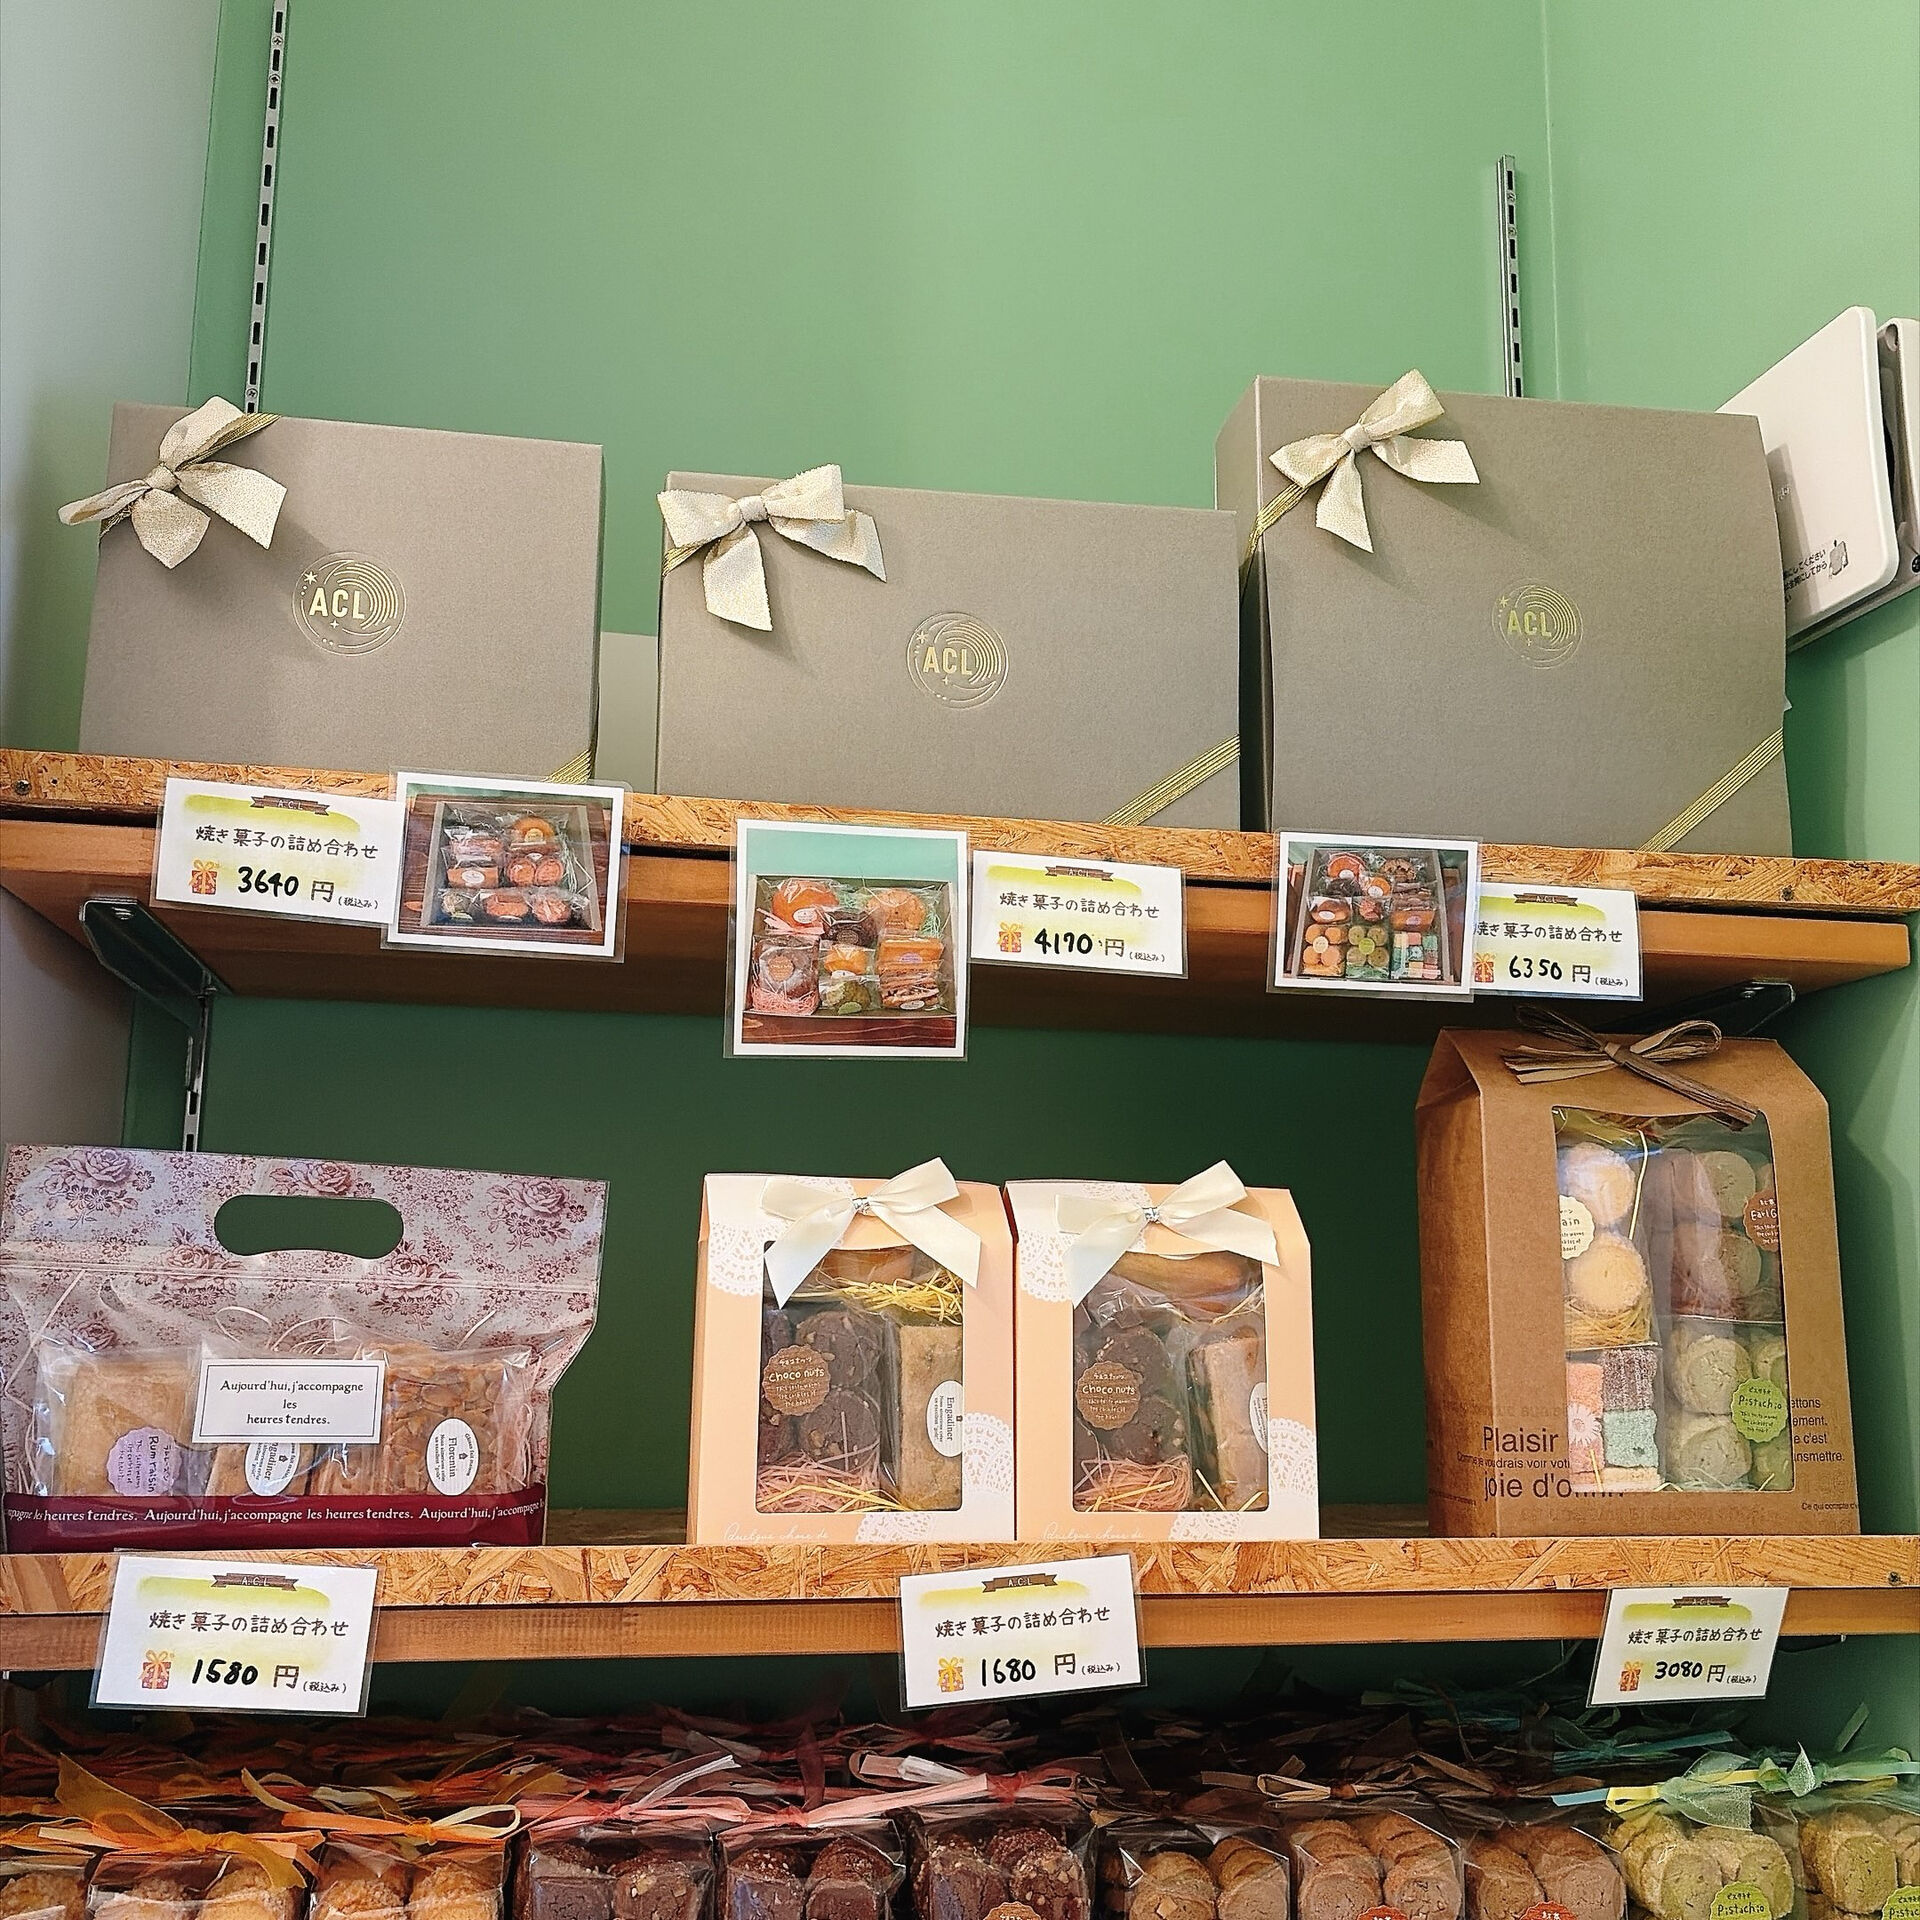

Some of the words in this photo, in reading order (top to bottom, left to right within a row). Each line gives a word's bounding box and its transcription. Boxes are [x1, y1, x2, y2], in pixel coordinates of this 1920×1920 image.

[308, 587, 365, 619] ACL
[1507, 610, 1552, 637] ACL
[923, 646, 973, 675] ACL
[195, 825, 378, 859] 焼き菓子の詰め合わせ
[237, 866, 299, 897] 3640
[311, 880, 334, 902] 円
[1000, 892, 1159, 918] 焼き菓子の詰め合わせ
[1034, 928, 1093, 954] 4170
[1104, 938, 1125, 957] 円
[1509, 955, 1563, 980] 6350
[1572, 964, 1591, 984] 円
[804, 1368, 824, 1378] nuts
[283, 1399, 298, 1409] les
[1116, 1386, 1136, 1395] nuts
[246, 1414, 283, 1424] heures
[285, 1414, 330, 1424] tendres.
[945, 1397, 955, 1441] Engadiner
[149, 1436, 159, 1459] Rum
[1484, 1426, 1558, 1452] Plaisir
[1803, 1433, 1827, 1443] c'est
[449, 1437, 457, 1477] Florentin
[1526, 1459, 1547, 1468] voir
[147, 1462, 157, 1493] raisin
[1484, 1471, 1522, 1501] joie
[44, 1509, 84, 1521] heures
[87, 1509, 137, 1521] tendres.
[307, 1508, 323, 1519] les
[325, 1508, 364, 1519] heures
[367, 1508, 413, 1519] tendres.
[149, 1610, 349, 1637] 焼き菓子の詰め合わせ
[935, 1606, 1110, 1637] 焼き菓子の詰め合わせ
[1627, 1627, 1762, 1645] 焼き菓子の詰め合わせ
[191, 1658, 258, 1685] 1580
[273, 1665, 299, 1689] 円
[981, 1658, 1036, 1686] 1680
[1054, 1653, 1076, 1676] 円
[1654, 1660, 1703, 1679] 3080
[1707, 1664, 1726, 1683] 円
